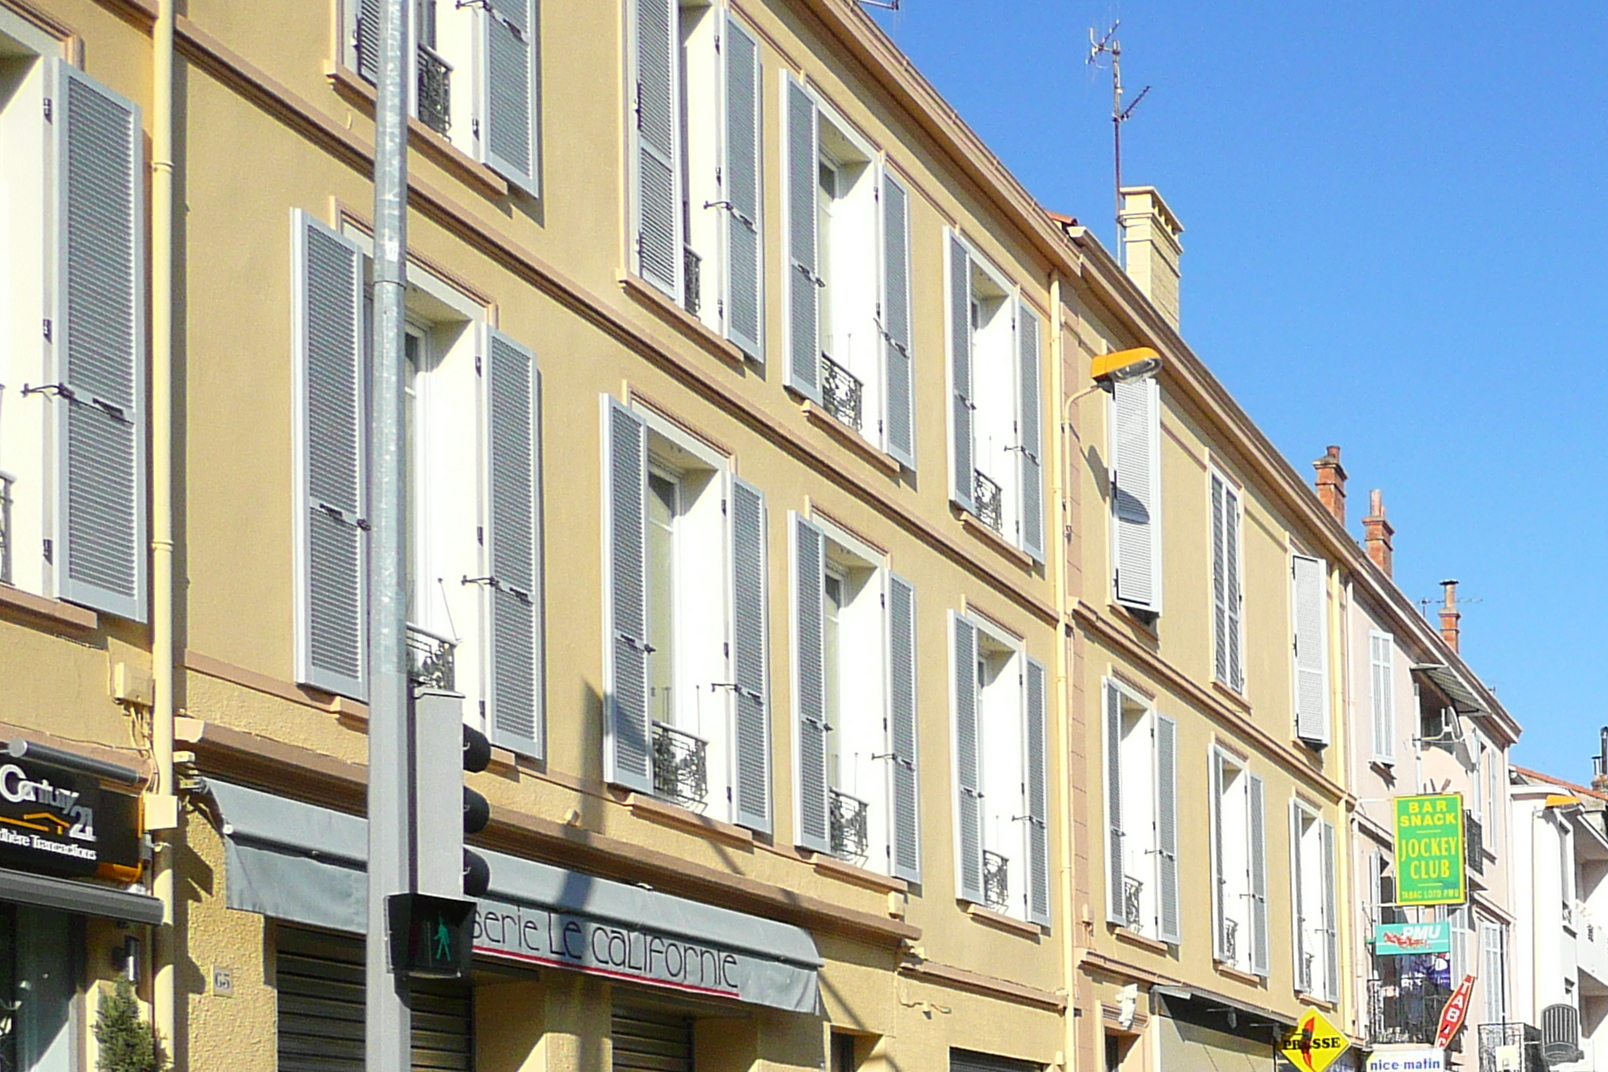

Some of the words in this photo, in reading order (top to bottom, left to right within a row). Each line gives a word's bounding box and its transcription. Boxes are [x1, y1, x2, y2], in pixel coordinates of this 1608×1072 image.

[1409, 800, 1447, 813] BAR
[1400, 812, 1457, 827] SNACK
[30, 834, 98, 860] Transactions
[1401, 836, 1457, 861] JOCKEY
[1410, 859, 1450, 879] CLUB
[1403, 924, 1442, 940] PMU
[215, 972, 230, 989] 65
[1283, 1037, 1342, 1051] PRSSE
